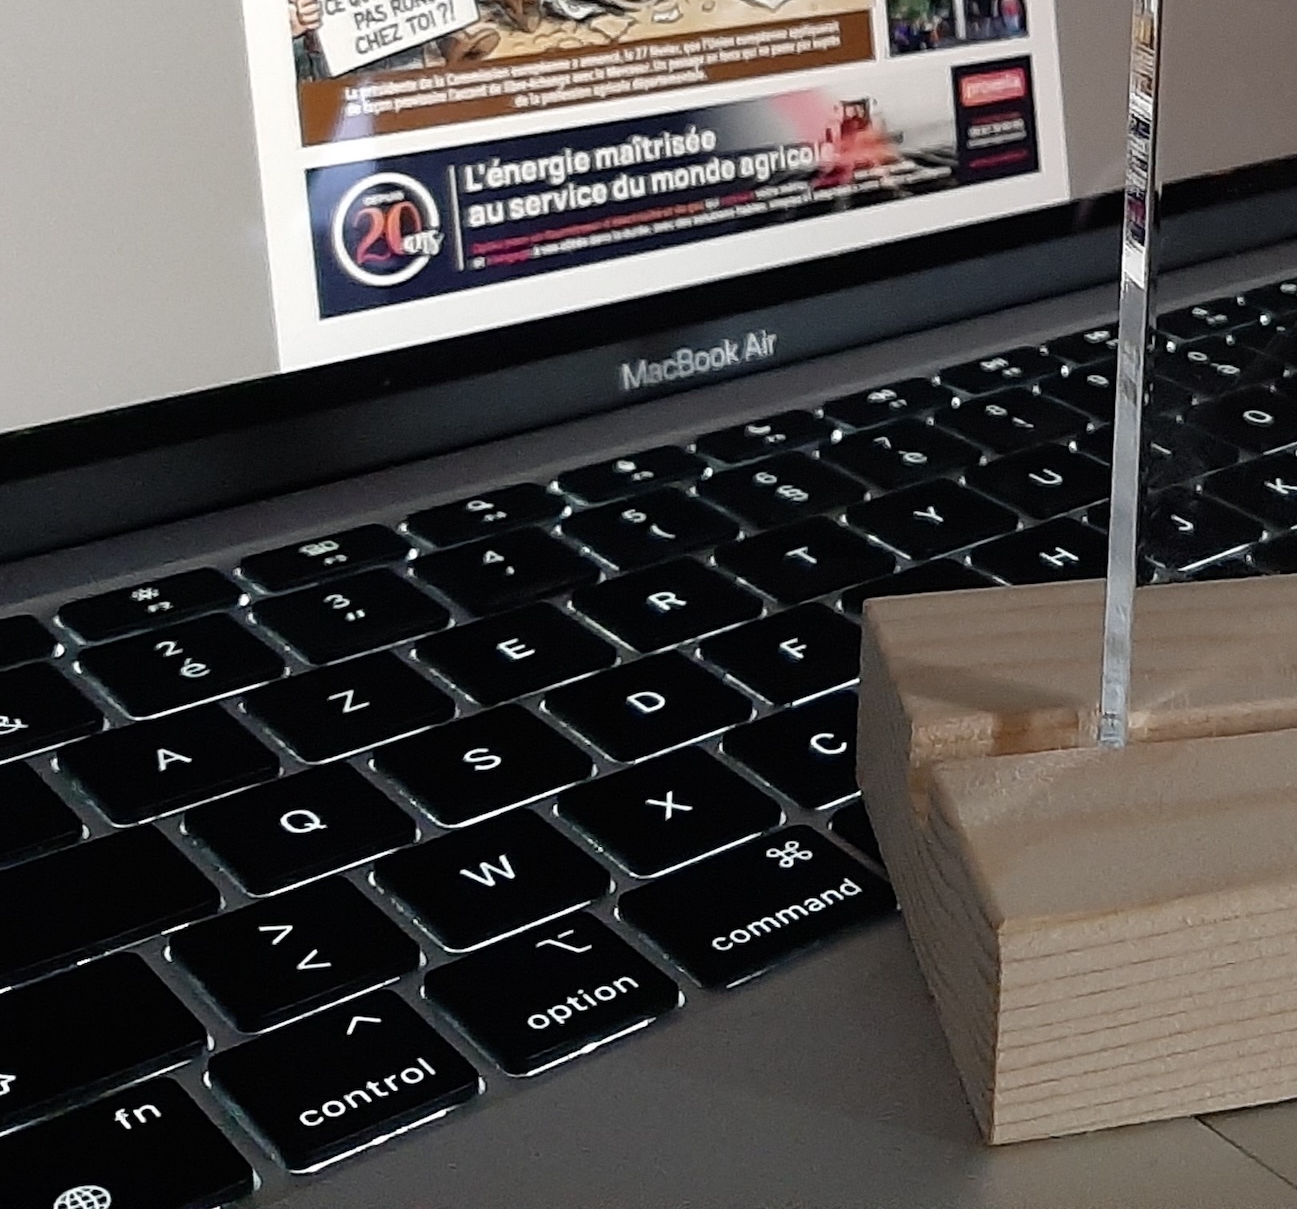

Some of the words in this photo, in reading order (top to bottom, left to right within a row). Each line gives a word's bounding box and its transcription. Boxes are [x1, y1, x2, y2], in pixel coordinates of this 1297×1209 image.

[354, 8, 386, 30] PAS
[355, 24, 402, 55] CHEZ
[406, 11, 435, 36] TOI
[462, 154, 590, 192] L'énergie
[594, 127, 718, 173] maîtrisée
[467, 202, 500, 228] au
[509, 184, 607, 222] service
[611, 170, 646, 201] du
[652, 158, 735, 194] monde
[353, 201, 421, 265] 20
[621, 339, 739, 390] MacBook
[745, 329, 777, 362] Air
[1029, 468, 1064, 487] U
[913, 505, 944, 525] Y
[784, 546, 818, 566] T
[1039, 546, 1080, 568] H
[647, 590, 687, 612] R
[155, 640, 184, 658] 2
[496, 638, 535, 660] E
[779, 638, 807, 659] F
[328, 690, 370, 715] Z
[626, 691, 666, 713] D
[810, 733, 848, 755] C
[157, 748, 192, 771] A
[462, 747, 502, 771] S
[645, 791, 693, 821] X
[280, 809, 327, 834] Q
[460, 854, 517, 888] W
[711, 877, 863, 952] command
[527, 974, 640, 1032] option
[299, 1057, 436, 1128] control
[114, 1103, 161, 1129] fn
